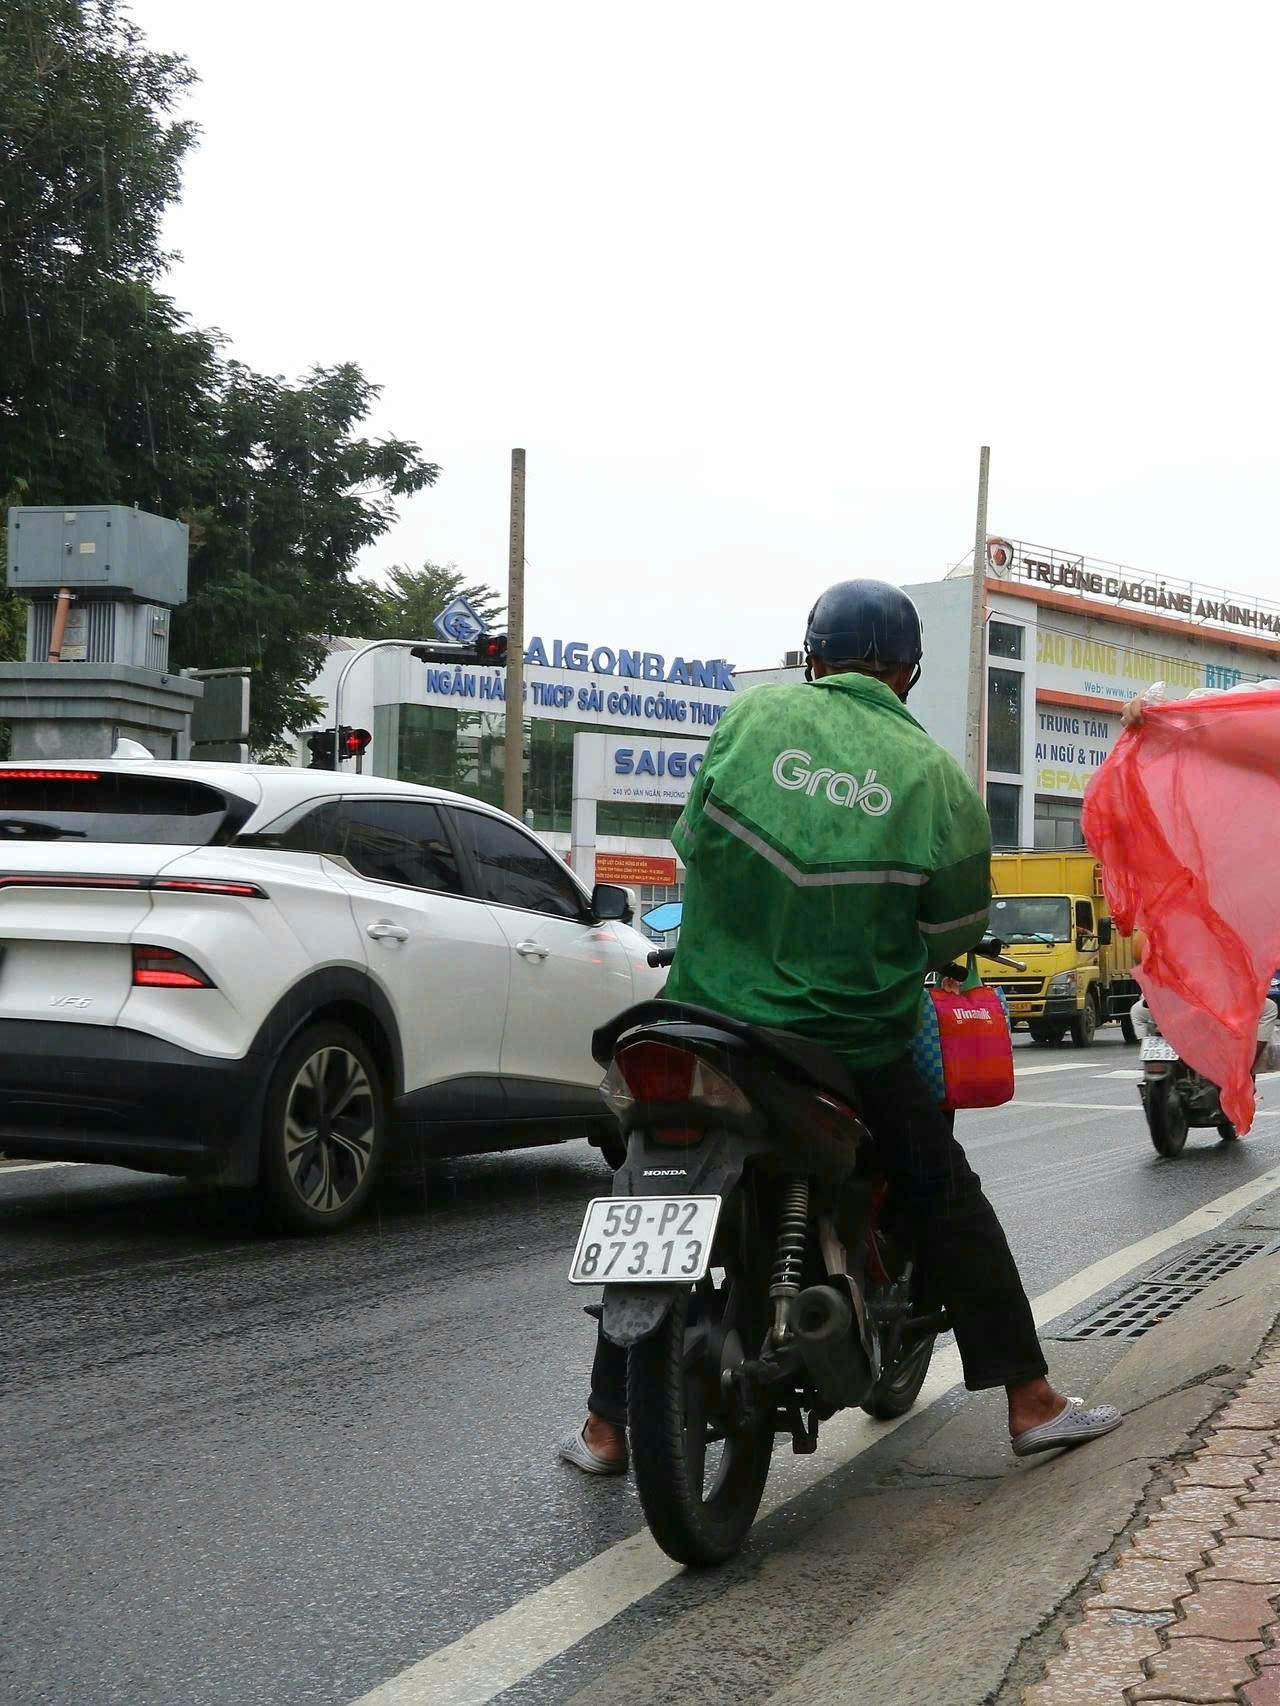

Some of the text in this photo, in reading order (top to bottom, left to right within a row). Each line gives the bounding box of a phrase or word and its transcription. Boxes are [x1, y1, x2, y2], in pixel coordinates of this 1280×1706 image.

[1023, 558, 1103, 594] TRƯỜNG
[1105, 577, 1142, 602] CAO
[1143, 581, 1192, 613] ĐẲNG
[1195, 598, 1219, 620] AN
[1220, 602, 1257, 629] NINH
[523, 636, 737, 691] AIGONBANK
[426, 665, 476, 698] NGÂN
[531, 682, 575, 709] TMCP
[577, 682, 604, 712] SÀI
[607, 686, 642, 717] GÒN
[644, 691, 687, 722] CÔNG
[1084, 680, 1104, 694] Web:
[1039, 713, 1108, 739] TRUNG TÂM
[1050, 743, 1075, 764] NGỮ
[1077, 748, 1086, 765] &
[772, 749, 892, 817] Grab
[602, 1202, 699, 1237] 59-P2
[580, 1240, 703, 1276] 873.13
